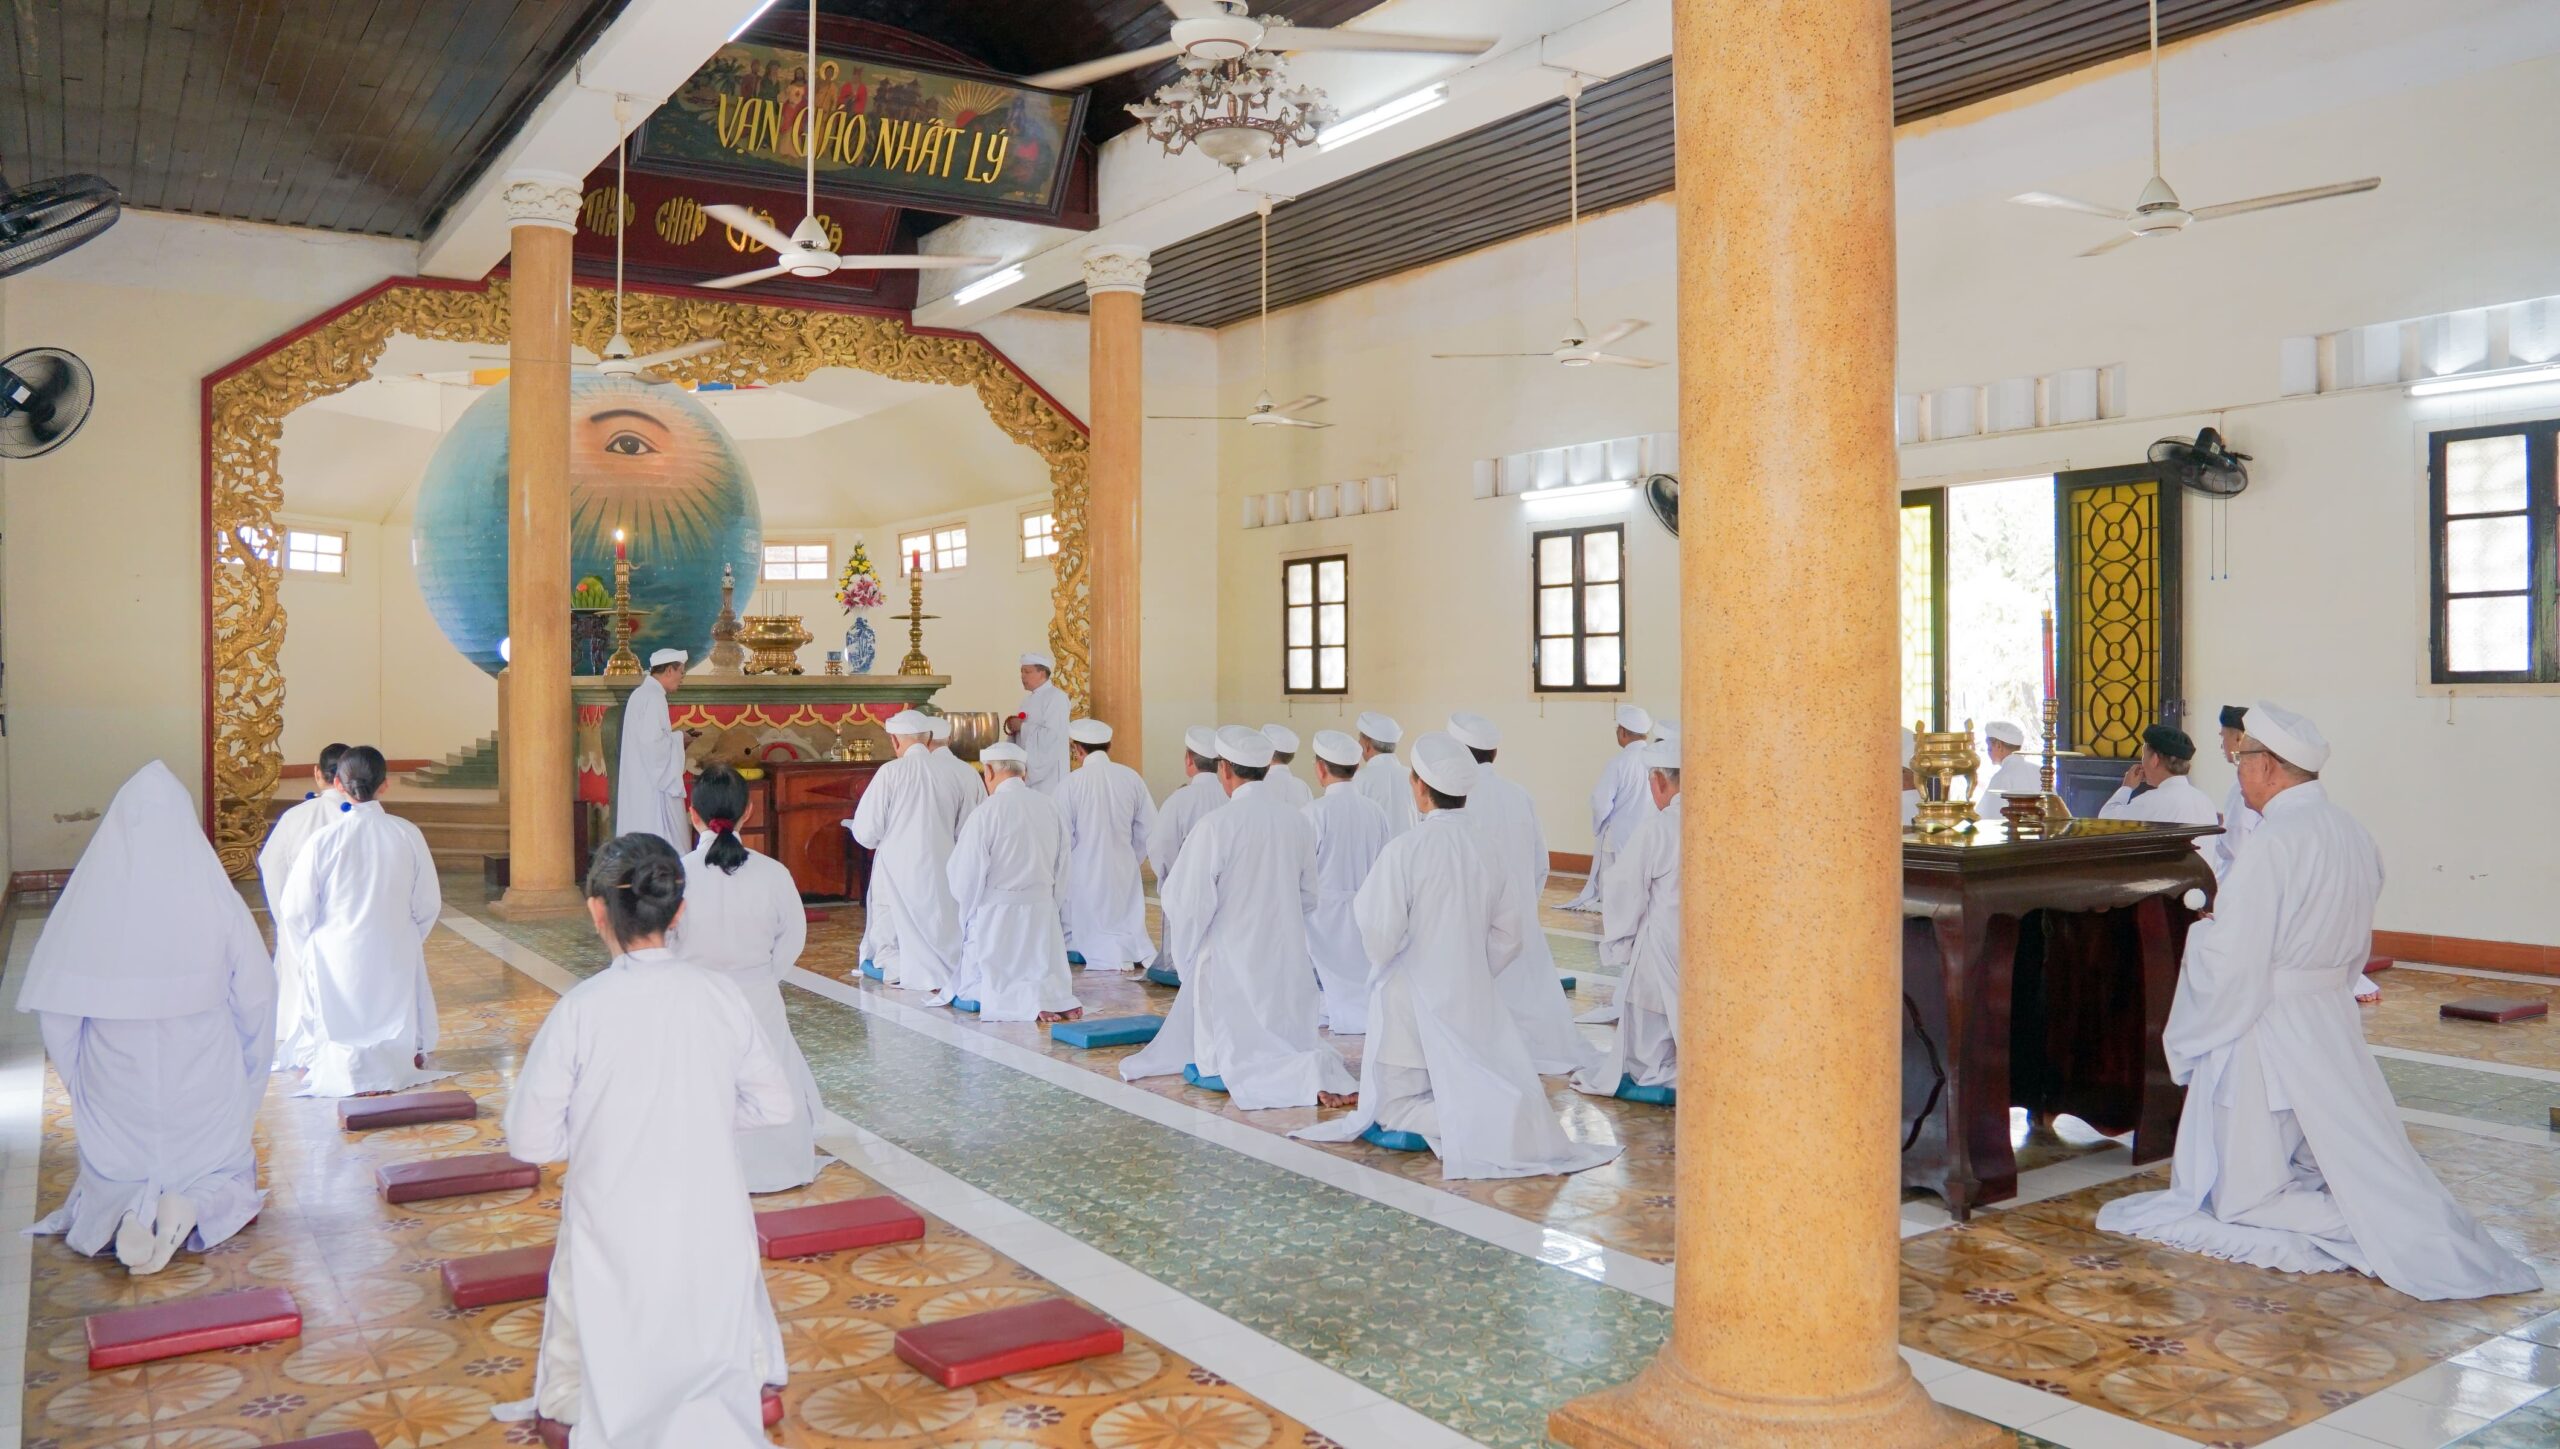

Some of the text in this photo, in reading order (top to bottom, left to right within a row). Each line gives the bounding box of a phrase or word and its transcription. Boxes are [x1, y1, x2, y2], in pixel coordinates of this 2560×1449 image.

[718, 93, 1009, 184] VẠN GIÁO NHẤT LÝ
